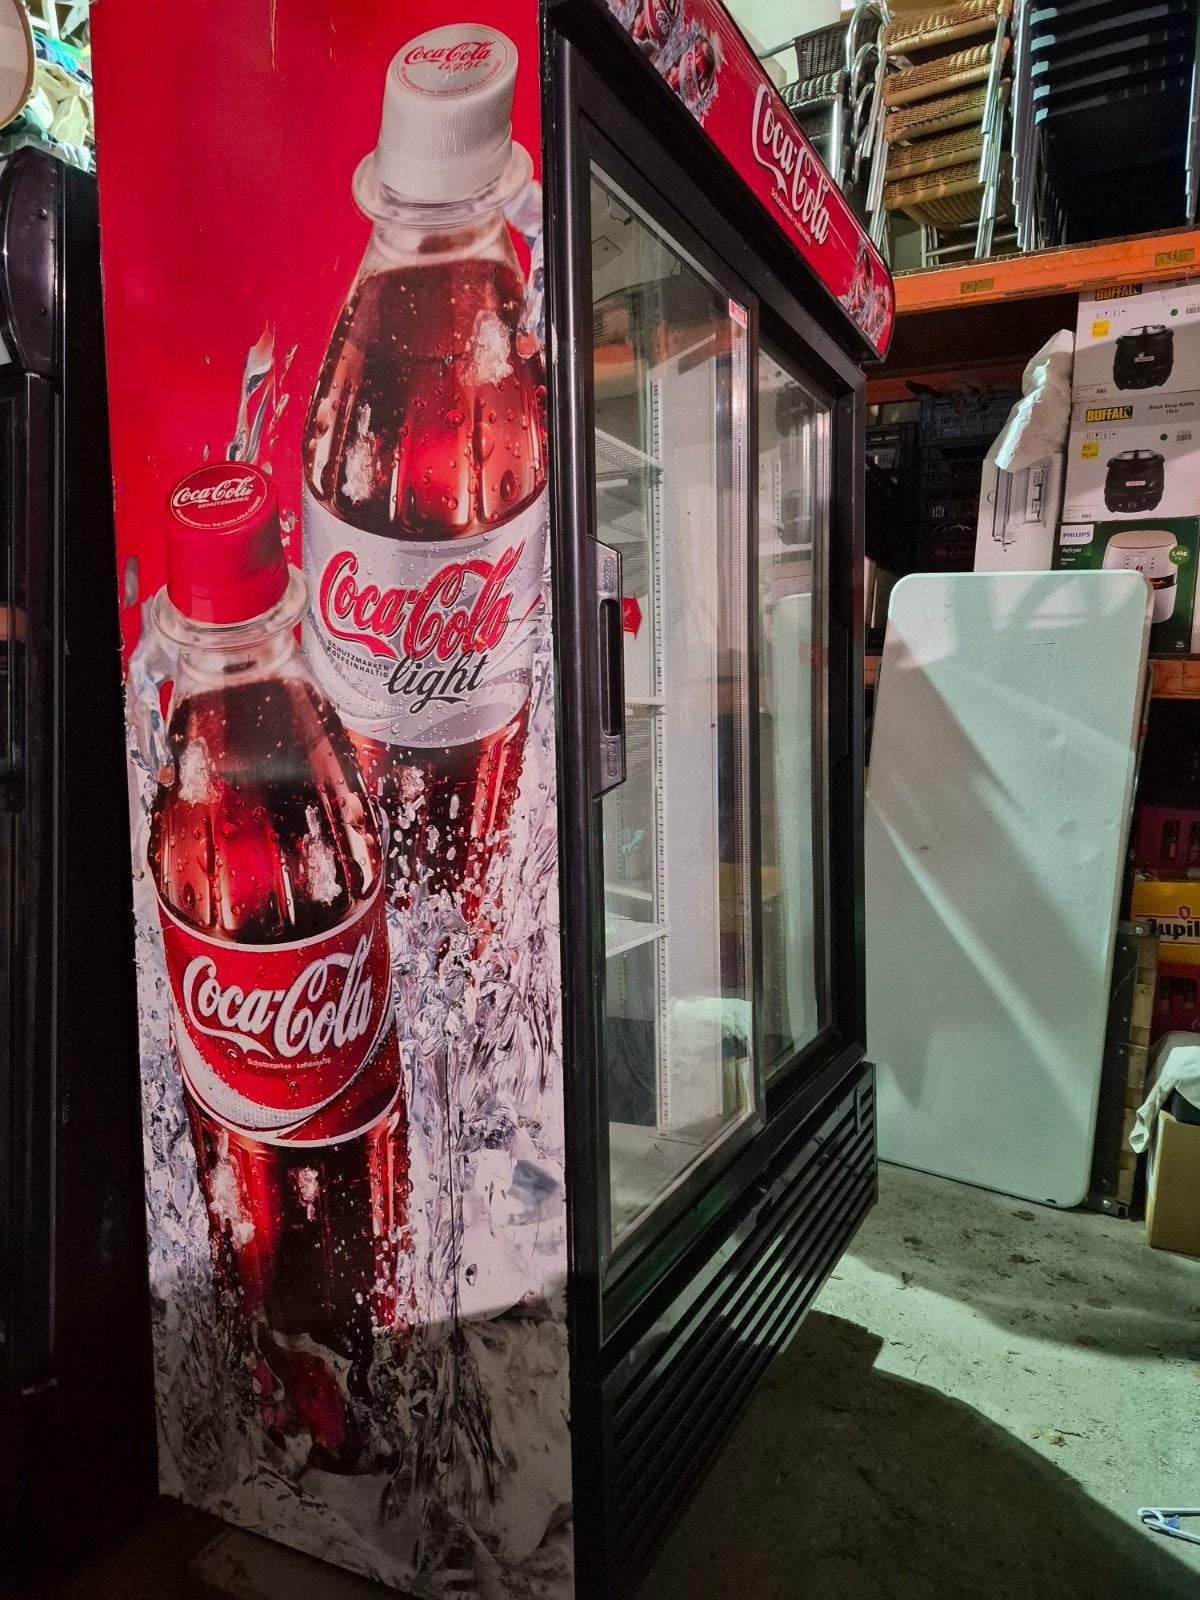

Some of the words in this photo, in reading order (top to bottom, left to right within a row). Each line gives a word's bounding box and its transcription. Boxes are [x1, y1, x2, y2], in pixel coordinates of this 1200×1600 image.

[403, 40, 496, 64] Coca-Cola
[751, 82, 831, 245] Coca-Cola
[172, 475, 256, 508] Coca-Cola
[1062, 531, 1091, 539] PHILIPS
[319, 537, 526, 663] Coca-Cola
[327, 639, 390, 672] SCHUTZMARKEN
[327, 646, 390, 679] KOFFEINHALTIG
[382, 650, 490, 715] light
[183, 924, 375, 1061] Coca-Cola
[247, 1057, 292, 1071] Schutzmarken
